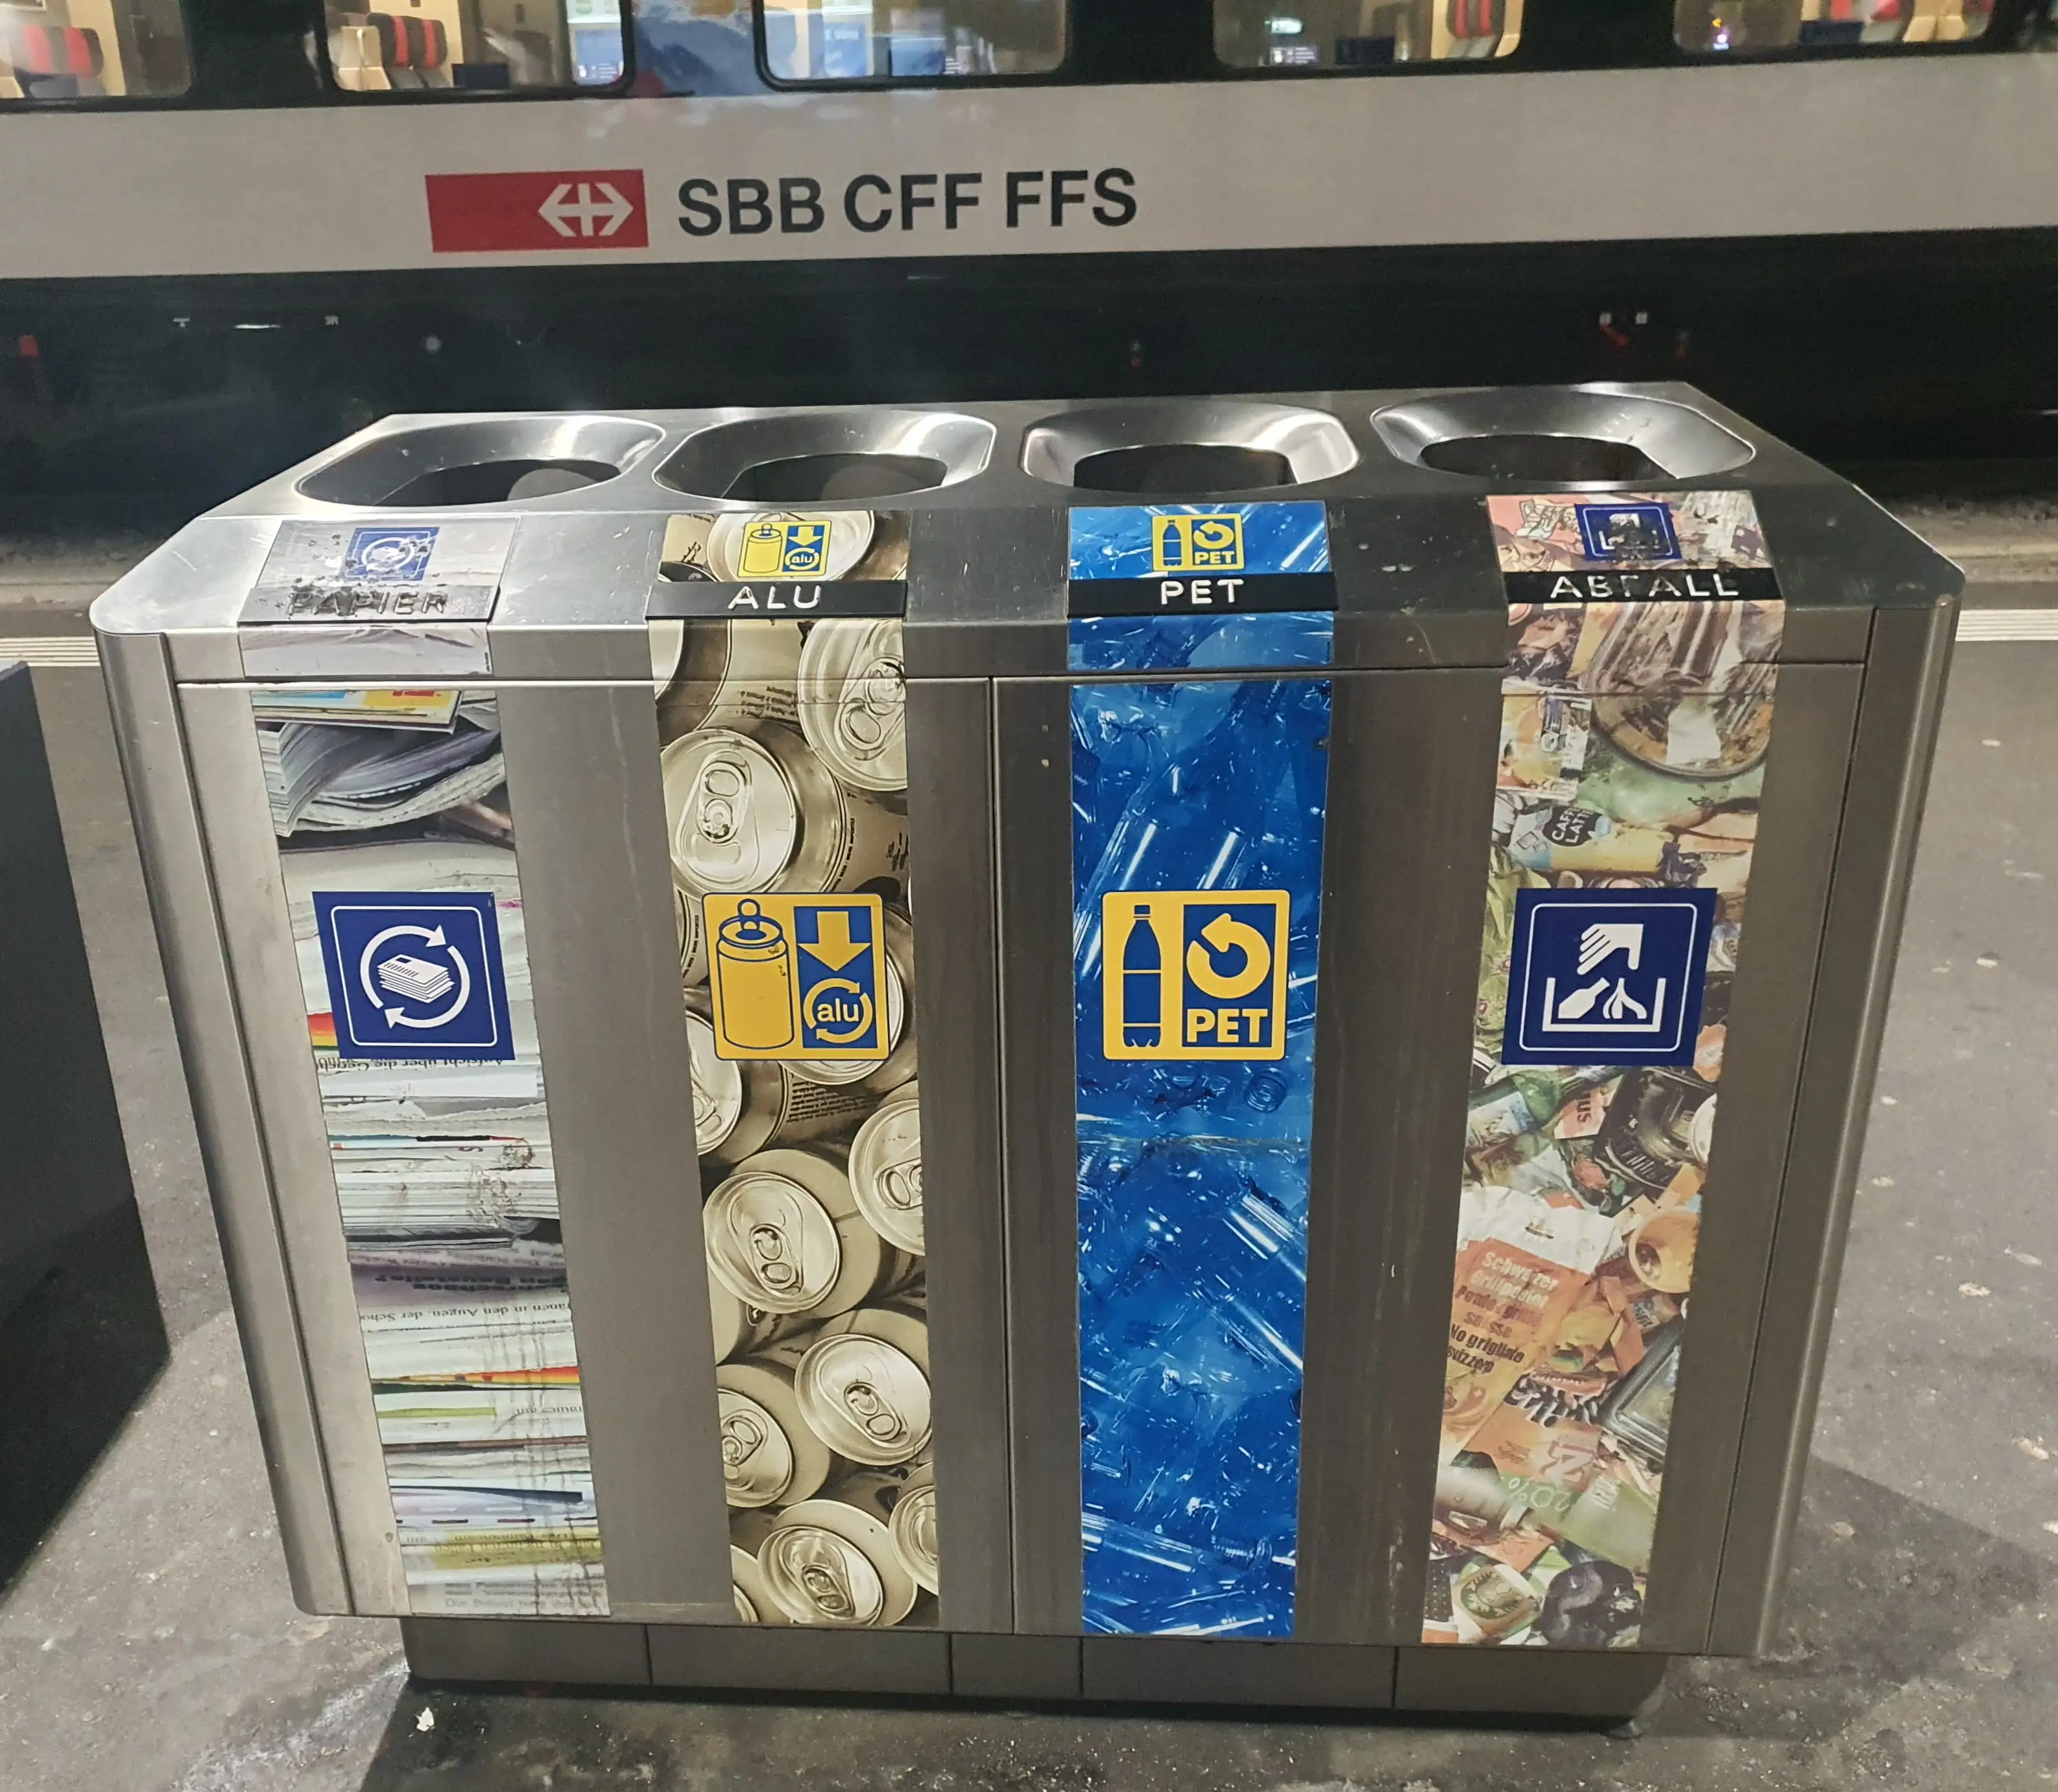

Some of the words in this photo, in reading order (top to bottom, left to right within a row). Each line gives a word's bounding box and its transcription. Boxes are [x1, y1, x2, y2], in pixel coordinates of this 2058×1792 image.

[678, 177, 825, 237] SBB
[844, 172, 983, 233] CFF
[1006, 167, 1137, 228] FFS
[791, 555, 813, 564] alu
[1194, 551, 1235, 564] PET
[287, 590, 448, 616] PAPIER
[728, 585, 822, 610] ALU
[1160, 579, 1245, 605] PET
[817, 999, 860, 1023] alu
[1187, 1008, 1268, 1043] PET
